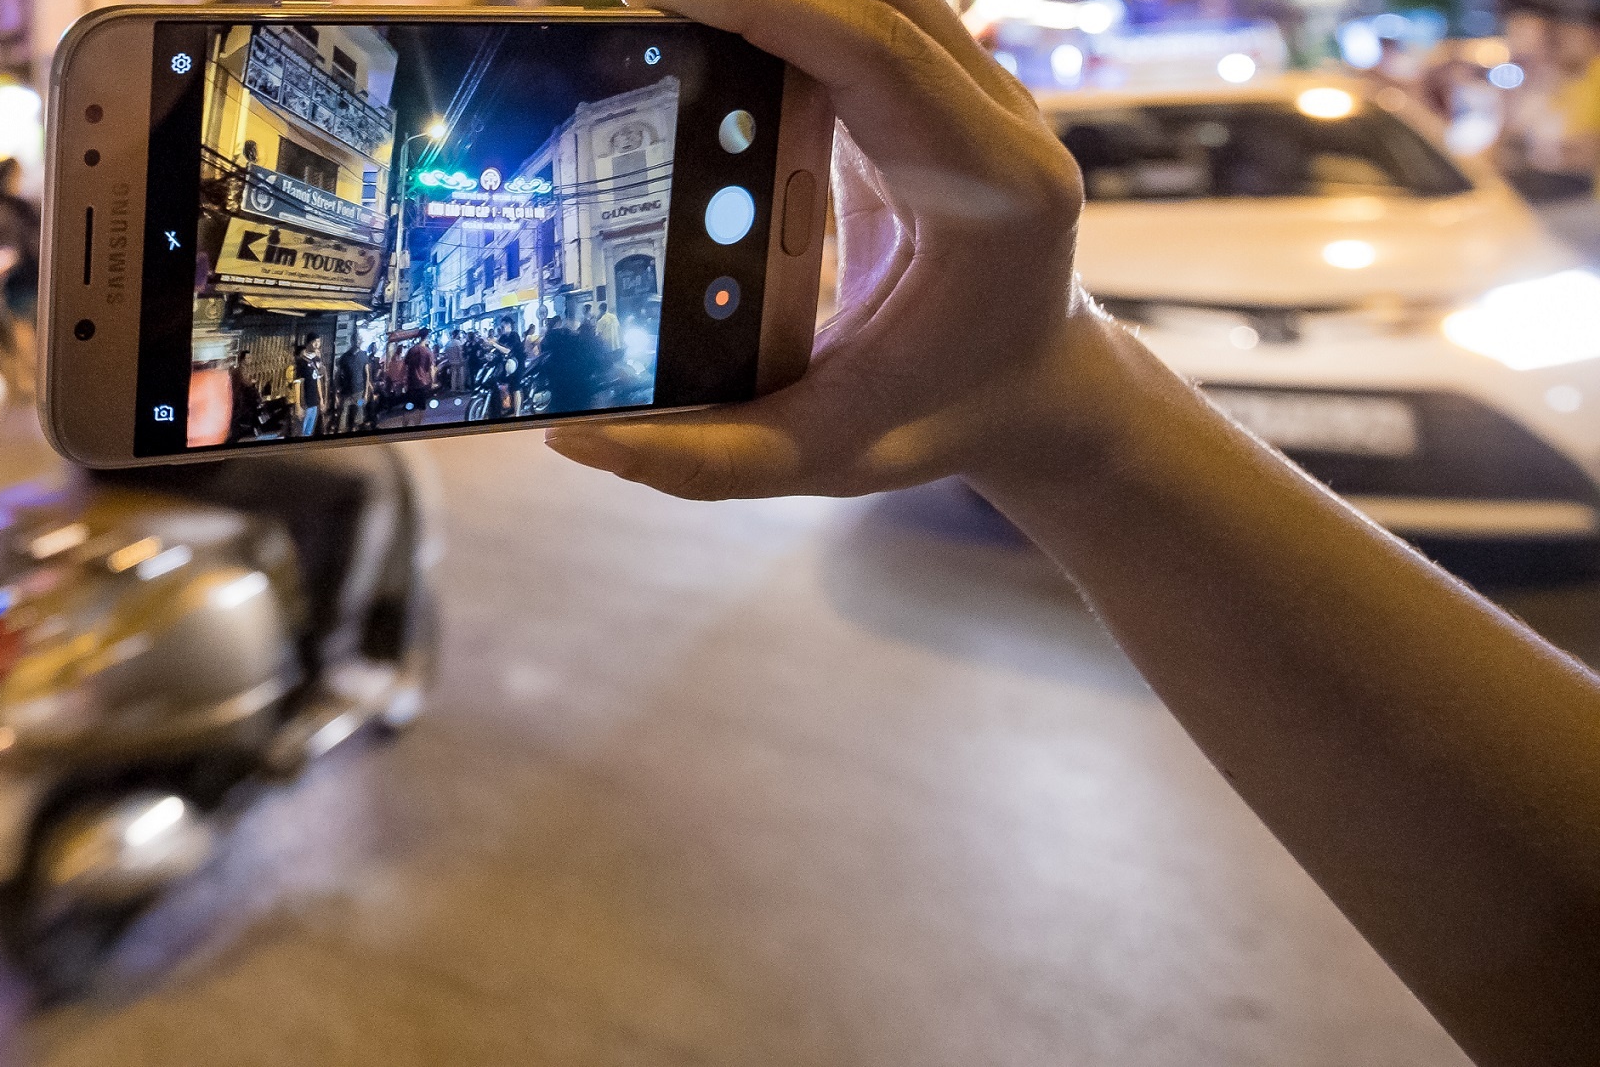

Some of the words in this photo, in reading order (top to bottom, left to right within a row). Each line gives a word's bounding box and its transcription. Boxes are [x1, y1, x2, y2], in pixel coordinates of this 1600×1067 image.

[282, 179, 312, 204] Hanoi
[311, 190, 337, 212] Street
[337, 200, 355, 219] Food
[106, 182, 129, 305] SAMSUNG
[237, 228, 297, 267] Kim
[302, 252, 353, 275] TOURS
